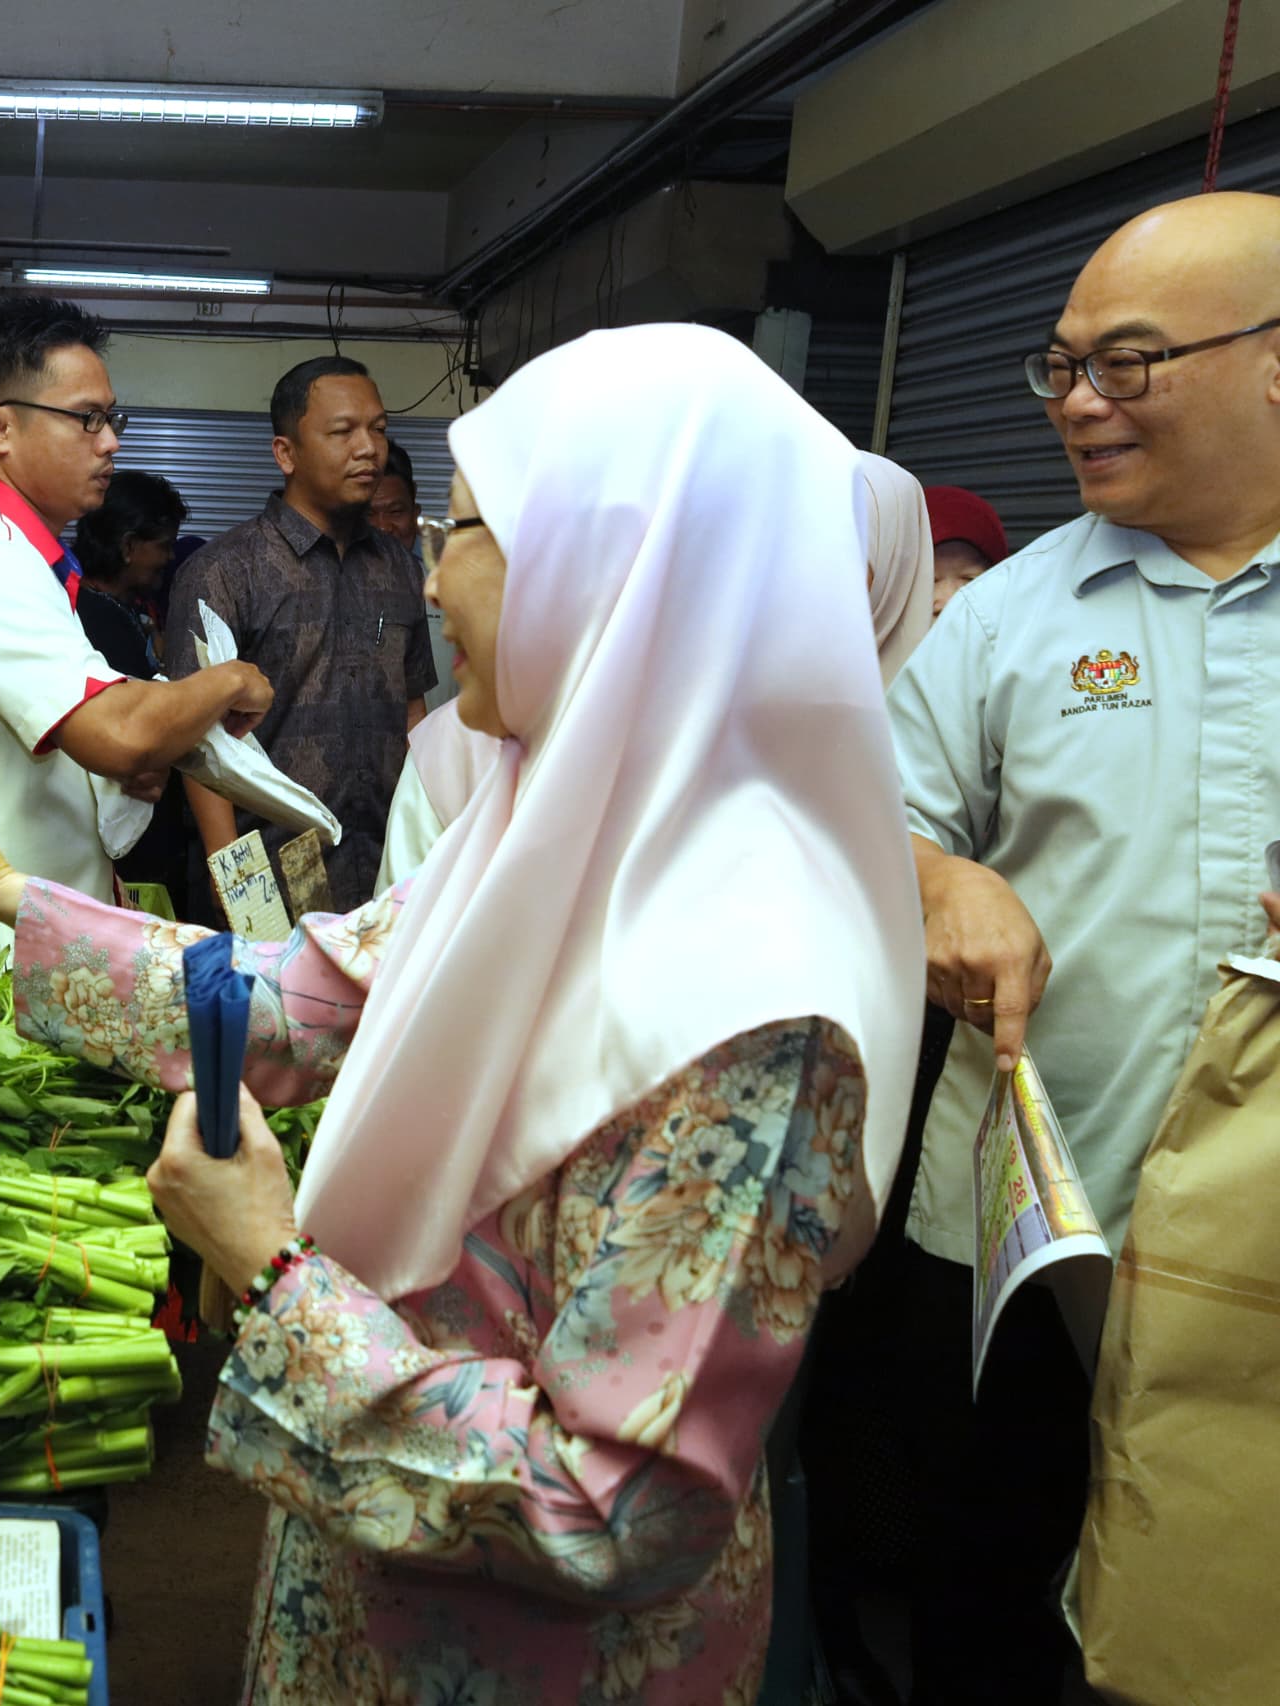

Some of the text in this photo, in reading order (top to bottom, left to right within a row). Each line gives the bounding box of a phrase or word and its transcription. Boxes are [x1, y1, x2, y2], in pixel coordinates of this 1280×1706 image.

[1084, 692, 1128, 703] PARLIMEN
[1061, 699, 1152, 717] BANDAR TUN RAZAK
[1013, 1176, 1027, 1205] 26
